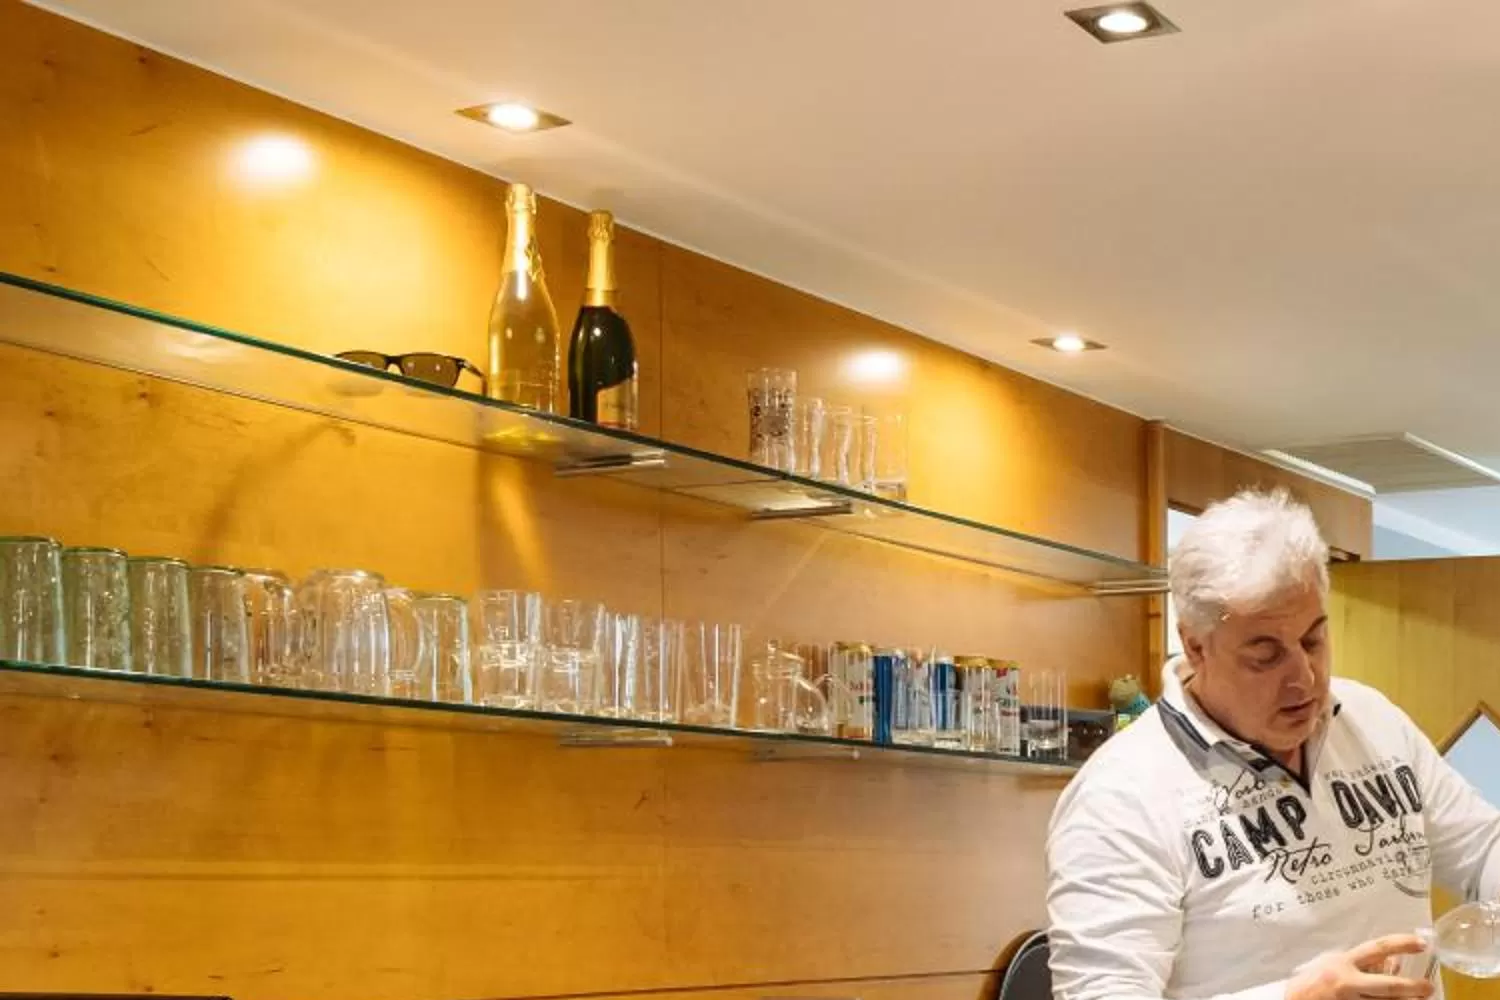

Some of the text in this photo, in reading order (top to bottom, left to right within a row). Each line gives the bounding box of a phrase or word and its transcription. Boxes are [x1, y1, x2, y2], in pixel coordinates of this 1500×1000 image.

[1191, 765, 1423, 879] CAMP DAVID
[1262, 836, 1332, 885] Retro
[1252, 902, 1285, 920] for
[1347, 875, 1375, 891] who
